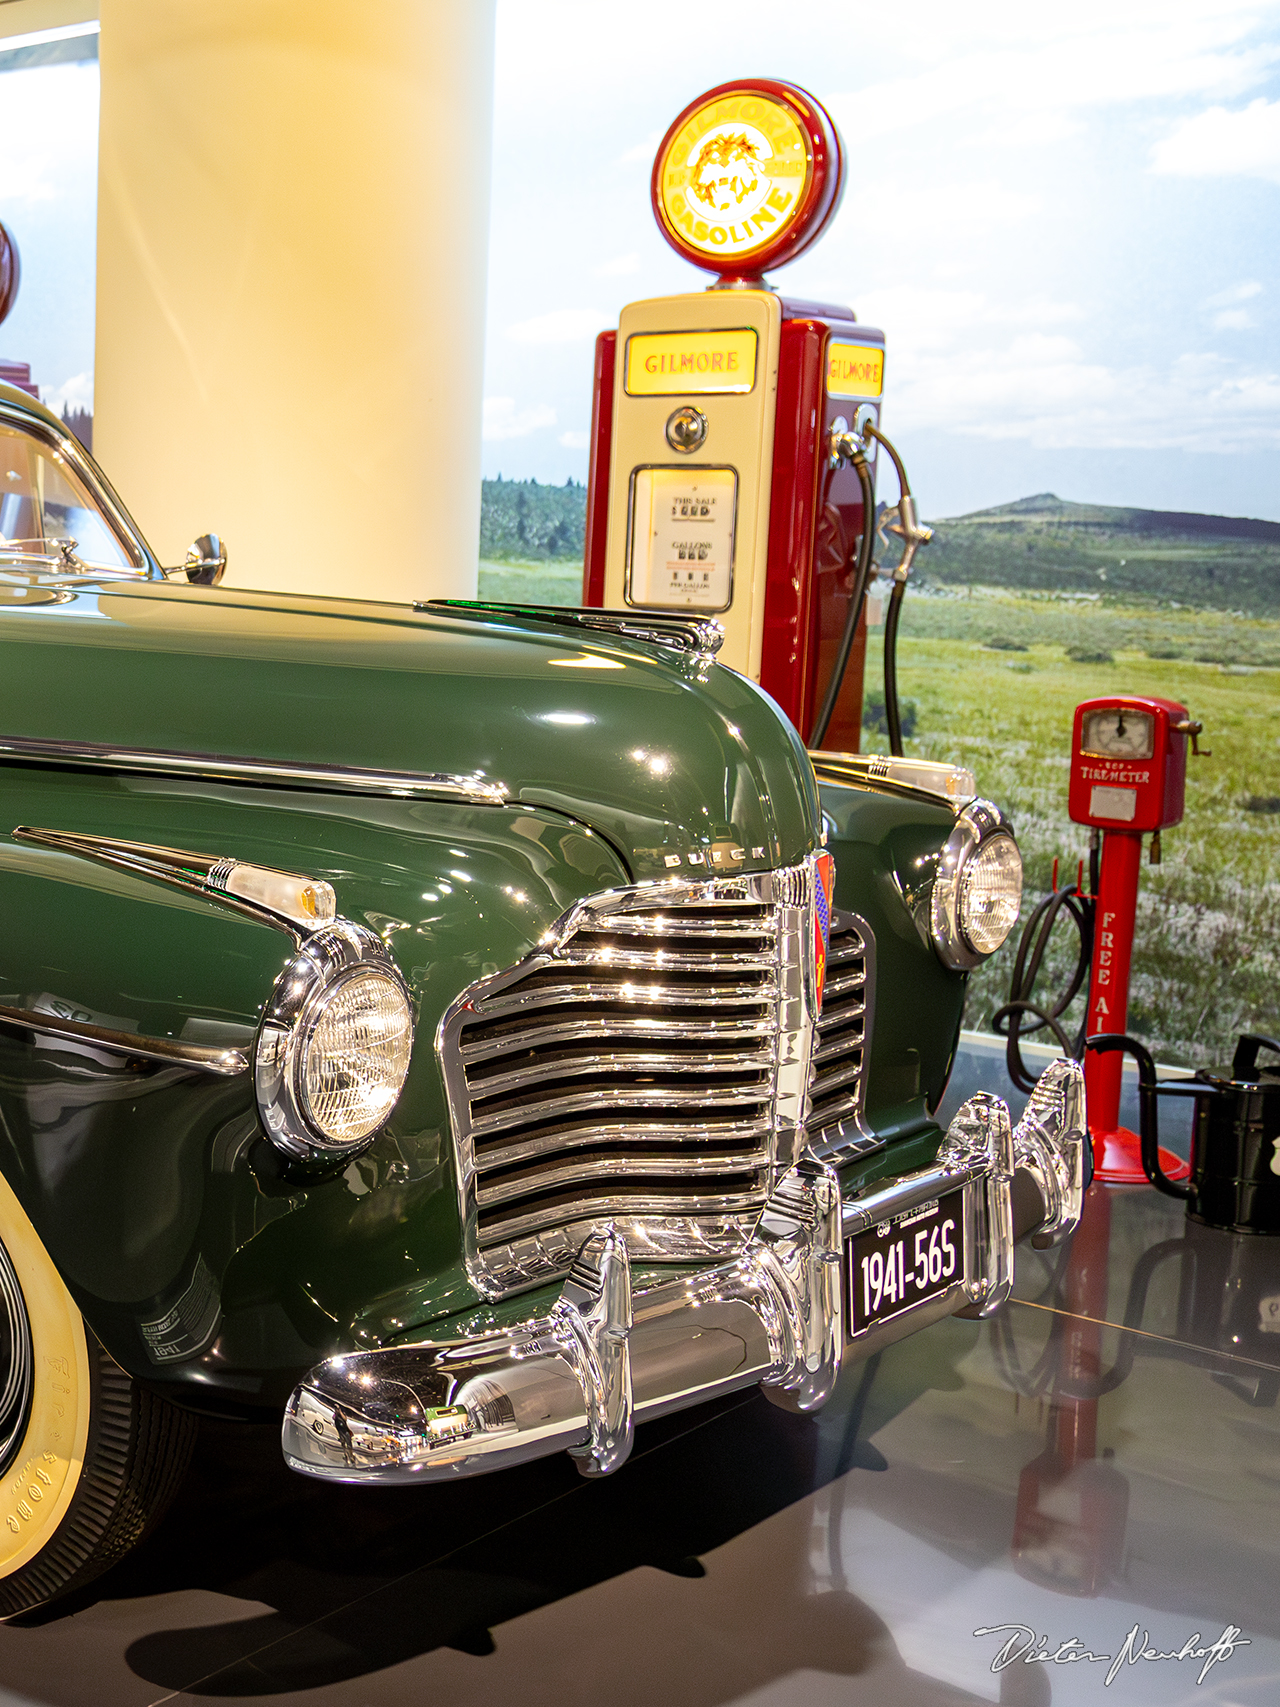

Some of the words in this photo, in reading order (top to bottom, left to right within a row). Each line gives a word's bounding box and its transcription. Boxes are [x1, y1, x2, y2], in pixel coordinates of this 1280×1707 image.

[671, 103, 796, 167] GILMORE
[671, 187, 794, 245] GASOLINE
[645, 351, 739, 374] GILMORE
[830, 359, 881, 383] GILMORE
[672, 541, 713, 549] GALLONS
[1080, 766, 1150, 784] TIREMETER
[664, 846, 767, 869] BUICK
[1097, 912, 1117, 985] FREE
[1095, 996, 1110, 1033] AI
[860, 1218, 956, 1317] 1941-56S
